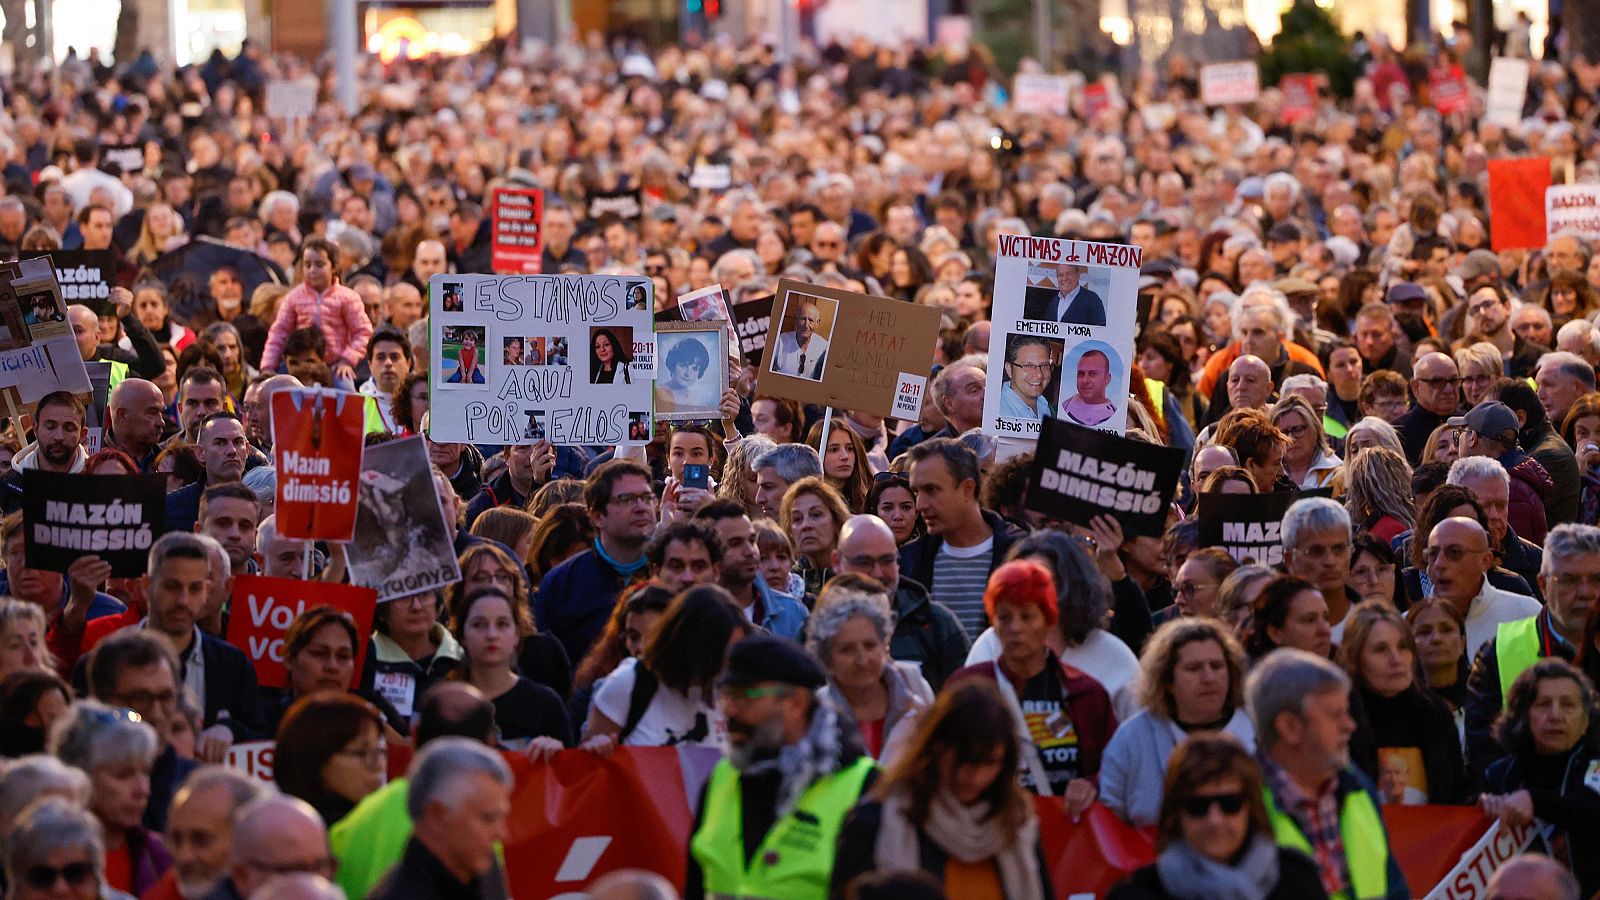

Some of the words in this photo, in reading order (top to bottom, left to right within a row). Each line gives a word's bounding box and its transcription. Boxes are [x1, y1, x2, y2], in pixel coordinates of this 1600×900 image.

[1066, 242, 1080, 262] de
[1086, 243, 1143, 269] MAZON
[56, 264, 101, 284] ZÓN
[474, 277, 621, 324] ESTAMOS
[855, 328, 908, 351] MATAT
[1067, 326, 1092, 337] MORA
[632, 342, 654, 353] 20:11
[901, 382, 920, 396] 20:11
[465, 401, 520, 442] POR
[551, 404, 628, 443] ELLOS
[1026, 422, 1042, 433] MO
[1057, 449, 1156, 492] MAZÓN
[1040, 468, 1161, 515] DIMISSIÓ
[46, 498, 143, 525] MAZÓN
[34, 522, 152, 551] DIMISSIÓ
[1223, 521, 1281, 543] MAZ
[1043, 747, 1078, 763] TOT
